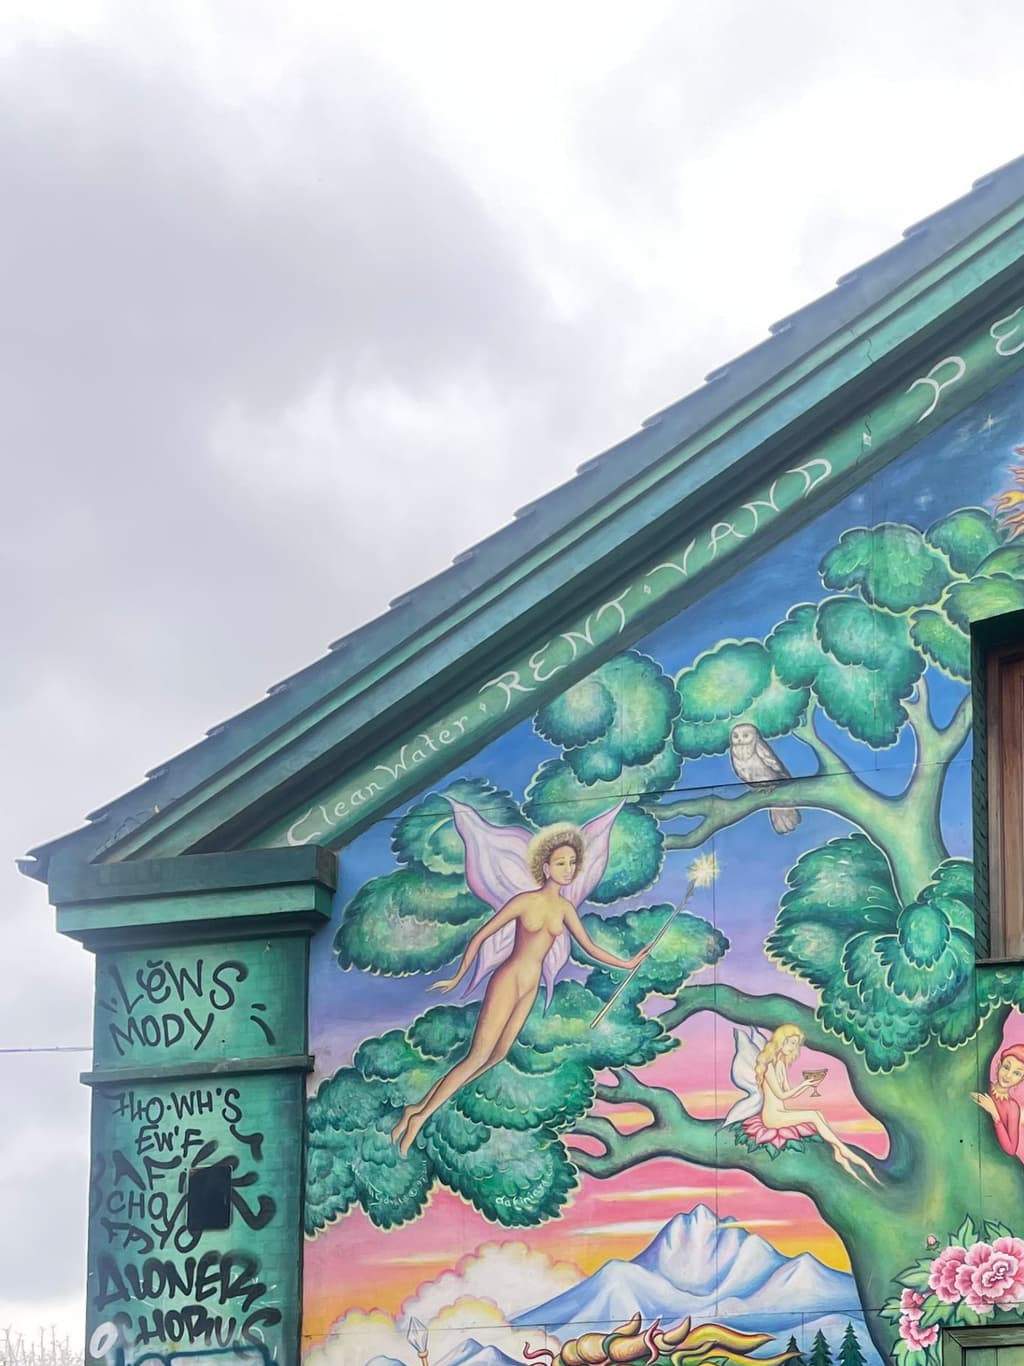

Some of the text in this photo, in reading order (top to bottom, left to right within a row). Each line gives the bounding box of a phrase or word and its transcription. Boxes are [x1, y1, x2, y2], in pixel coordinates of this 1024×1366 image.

[479, 458, 833, 712] RENT VAND
[287, 716, 468, 846] Clean Water
